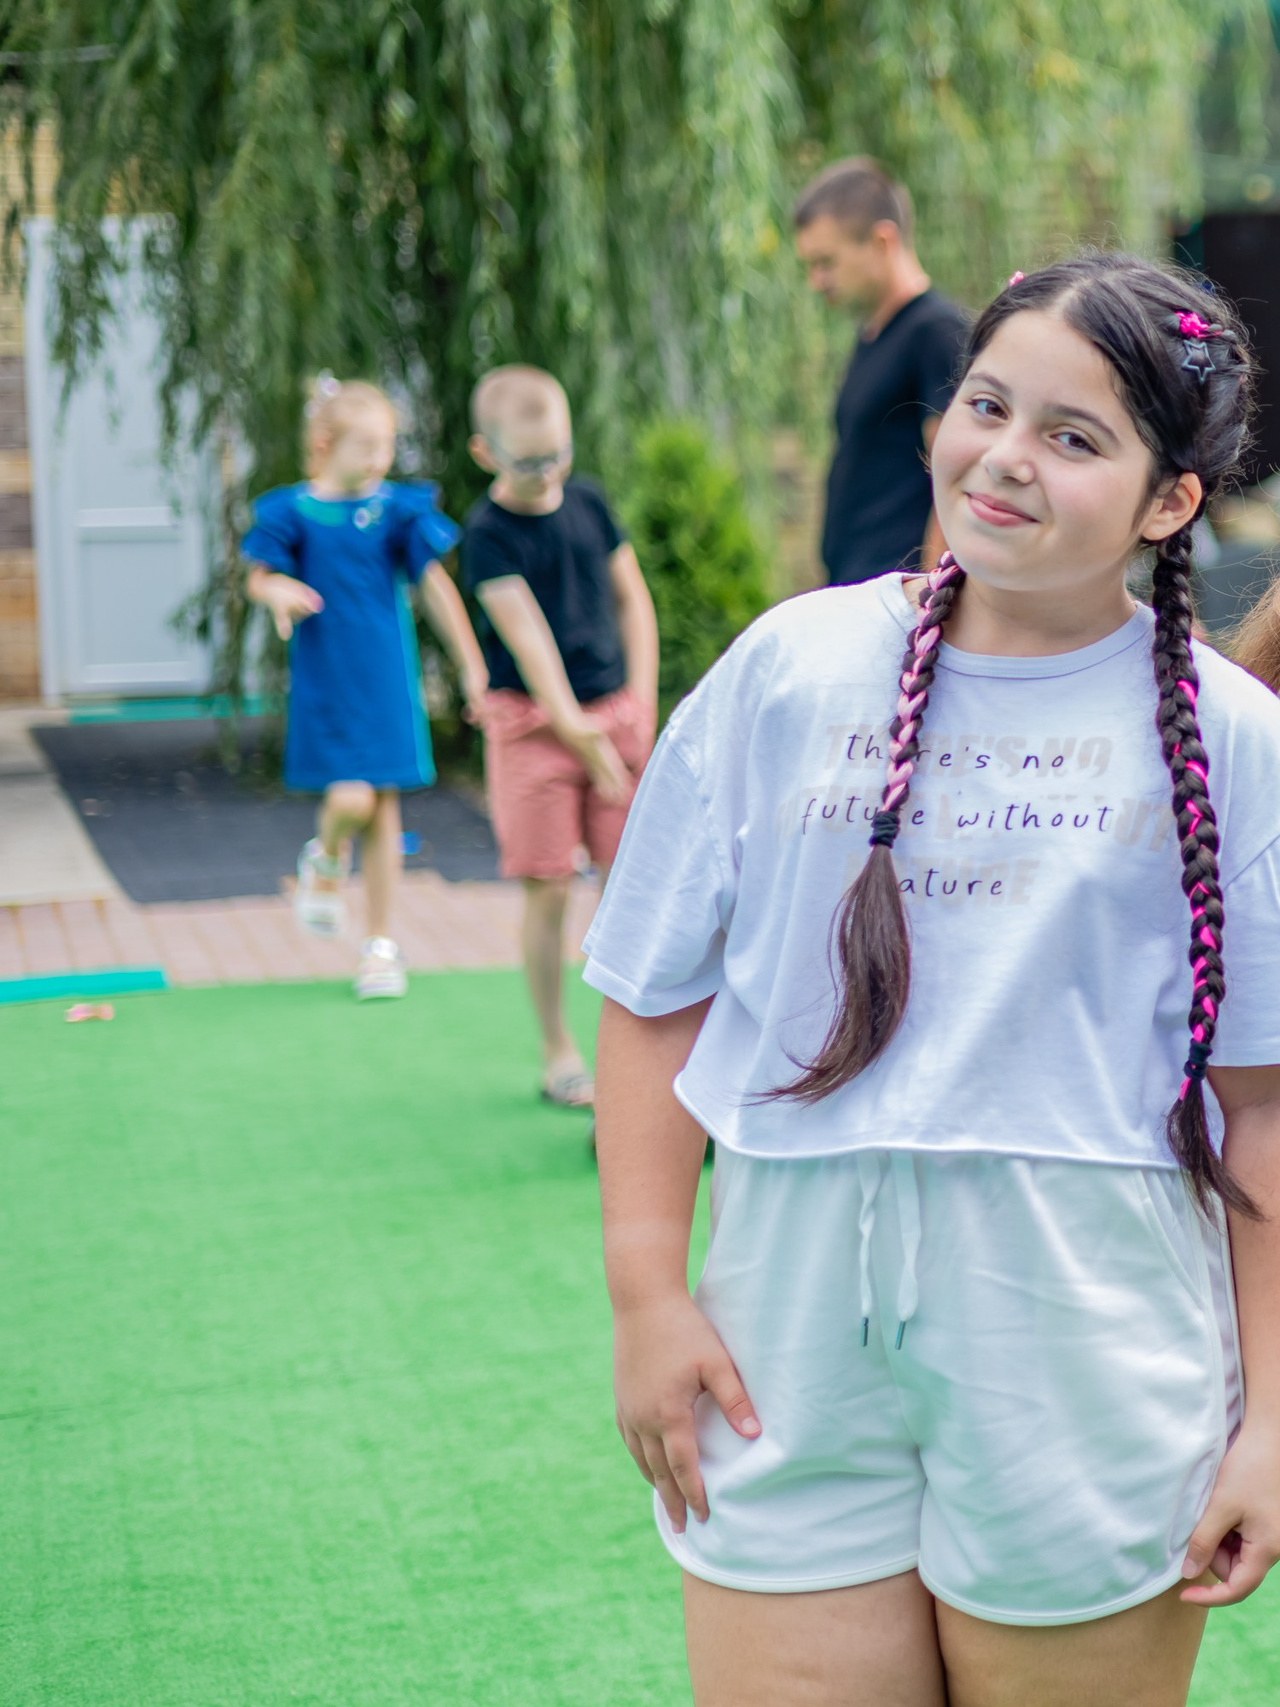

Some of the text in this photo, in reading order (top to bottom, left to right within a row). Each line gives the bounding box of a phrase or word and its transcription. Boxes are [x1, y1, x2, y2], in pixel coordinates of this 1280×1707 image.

[847, 733, 1065, 770] thre's no
[801, 795, 925, 835] futue
[957, 802, 1114, 832] without
[900, 868, 1004, 897] ature
